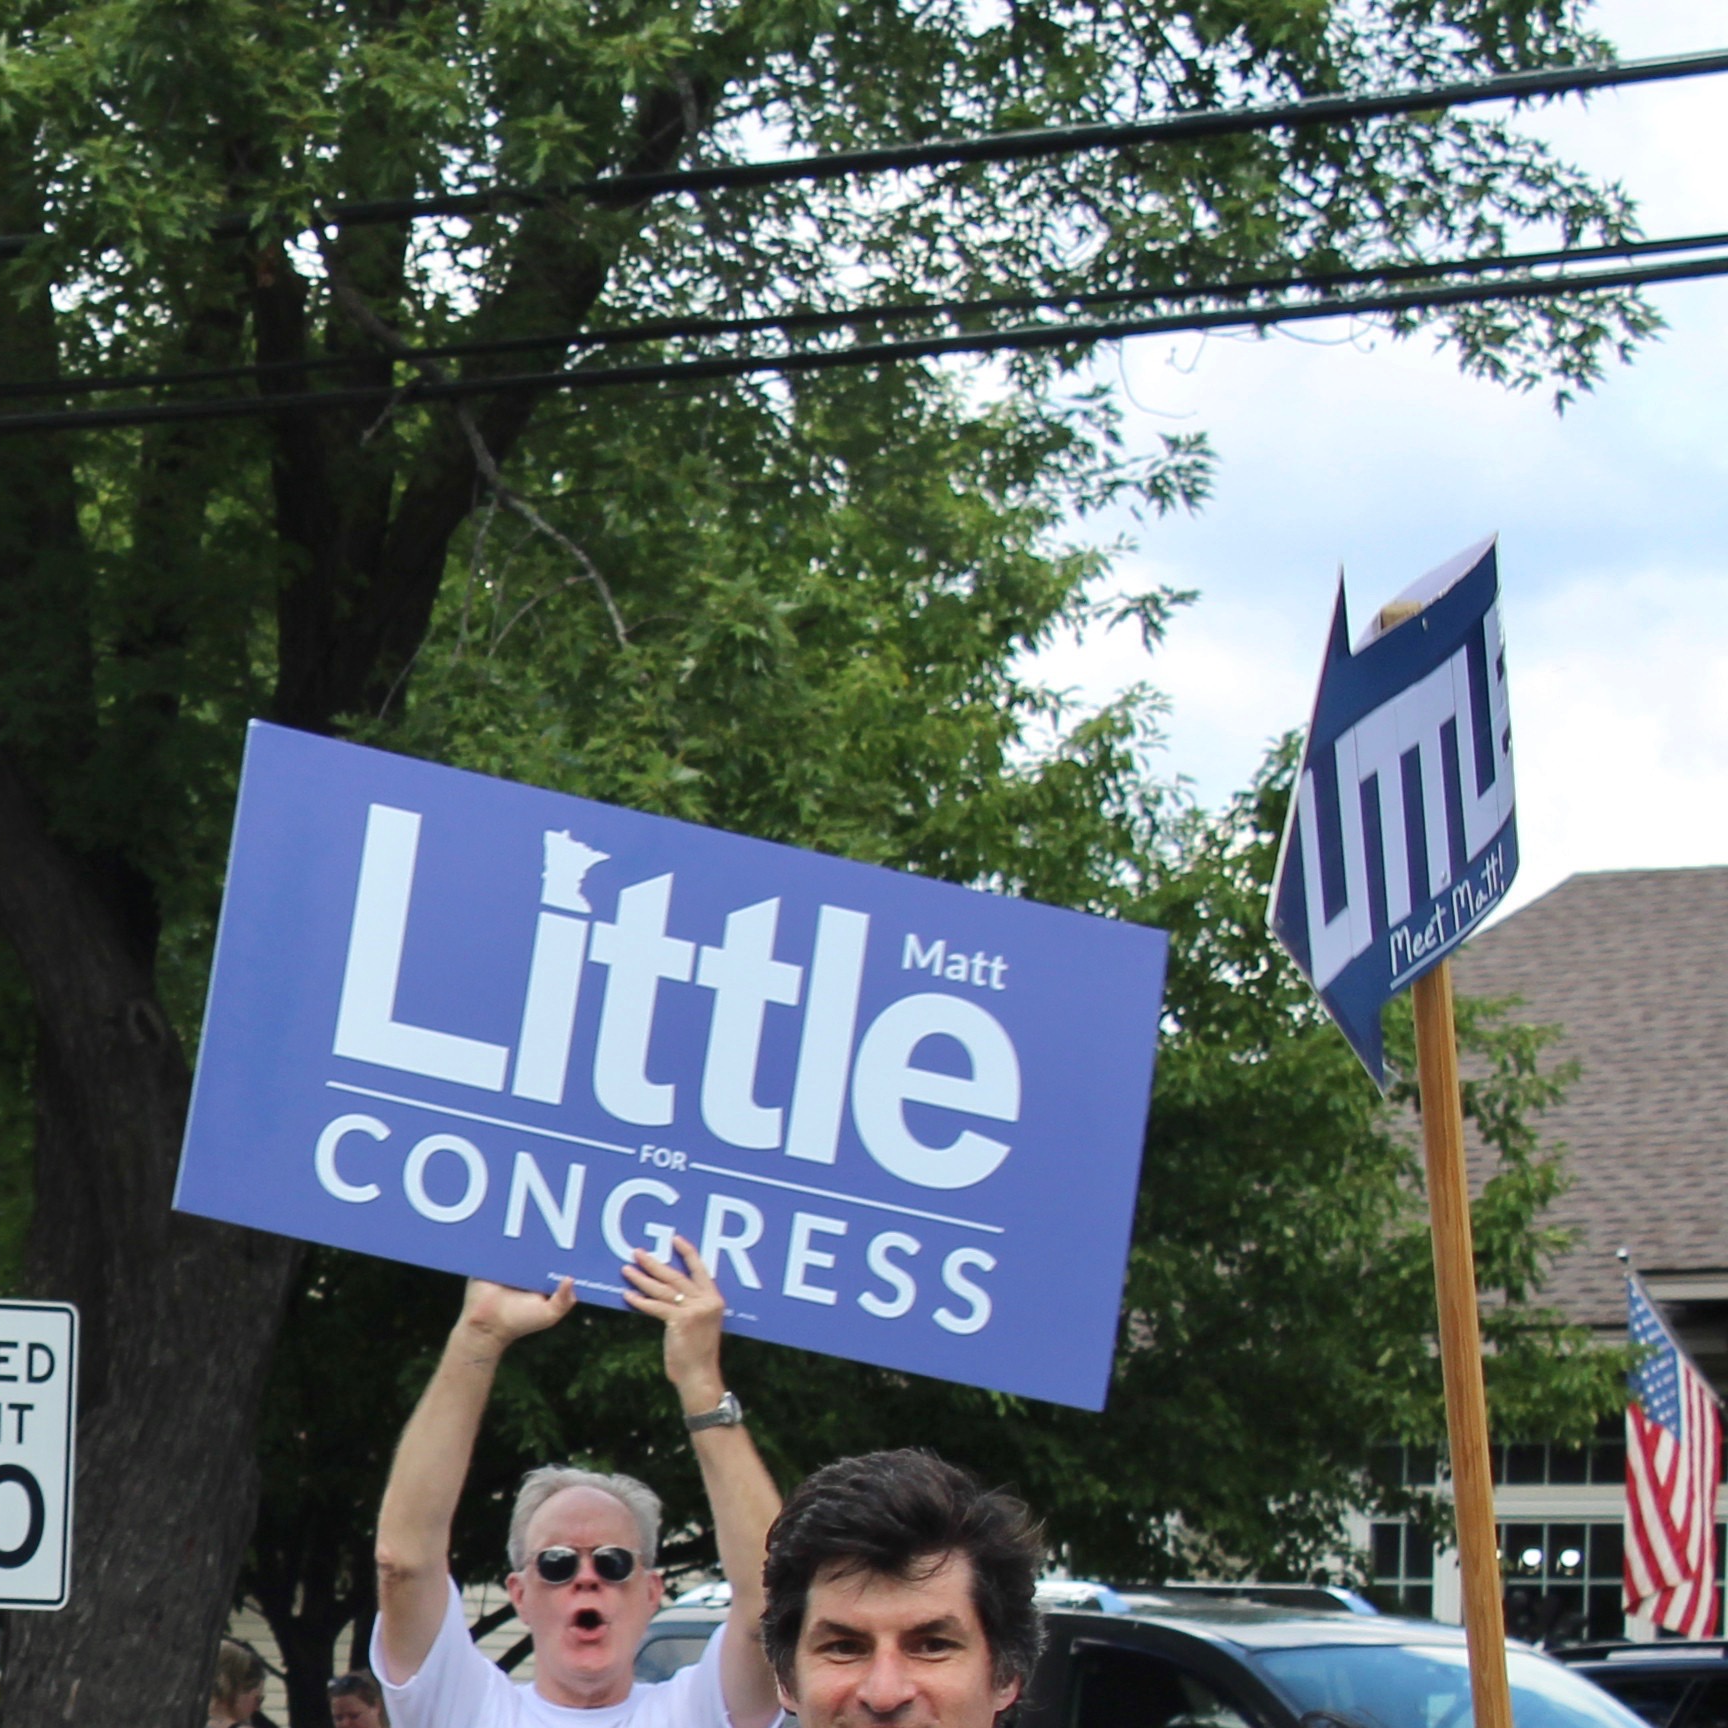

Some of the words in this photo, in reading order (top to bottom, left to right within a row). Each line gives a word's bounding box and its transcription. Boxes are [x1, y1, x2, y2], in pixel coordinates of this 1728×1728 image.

[902, 932, 1009, 991] Matt
[1389, 902, 1448, 977] Meet
[1451, 842, 1506, 931] Matt!
[331, 803, 1022, 1190] Little
[314, 1112, 998, 1336] CONGRESS
[639, 1143, 688, 1172] FOR
